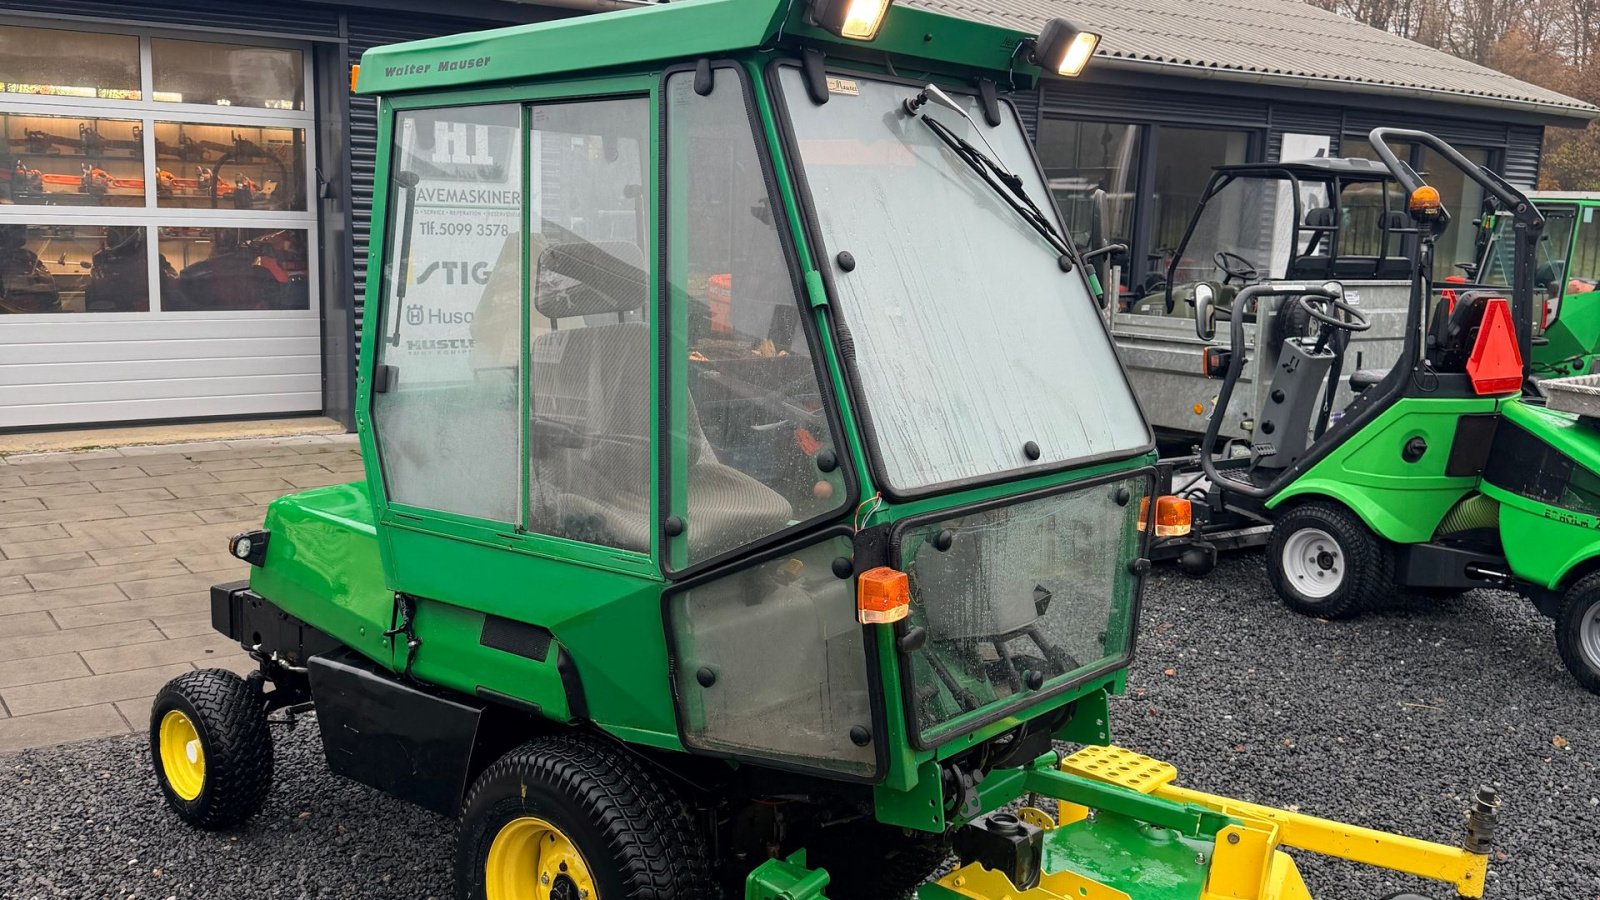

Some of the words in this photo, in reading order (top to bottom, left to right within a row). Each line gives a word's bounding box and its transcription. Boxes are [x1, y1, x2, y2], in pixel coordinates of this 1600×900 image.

[384, 63, 431, 77] Walter
[438, 56, 491, 72] Mauser
[416, 187, 520, 205] AVEMASKINER
[419, 221, 473, 236] Tlf.5099
[477, 223, 509, 237] 3578
[416, 261, 492, 285] STIG
